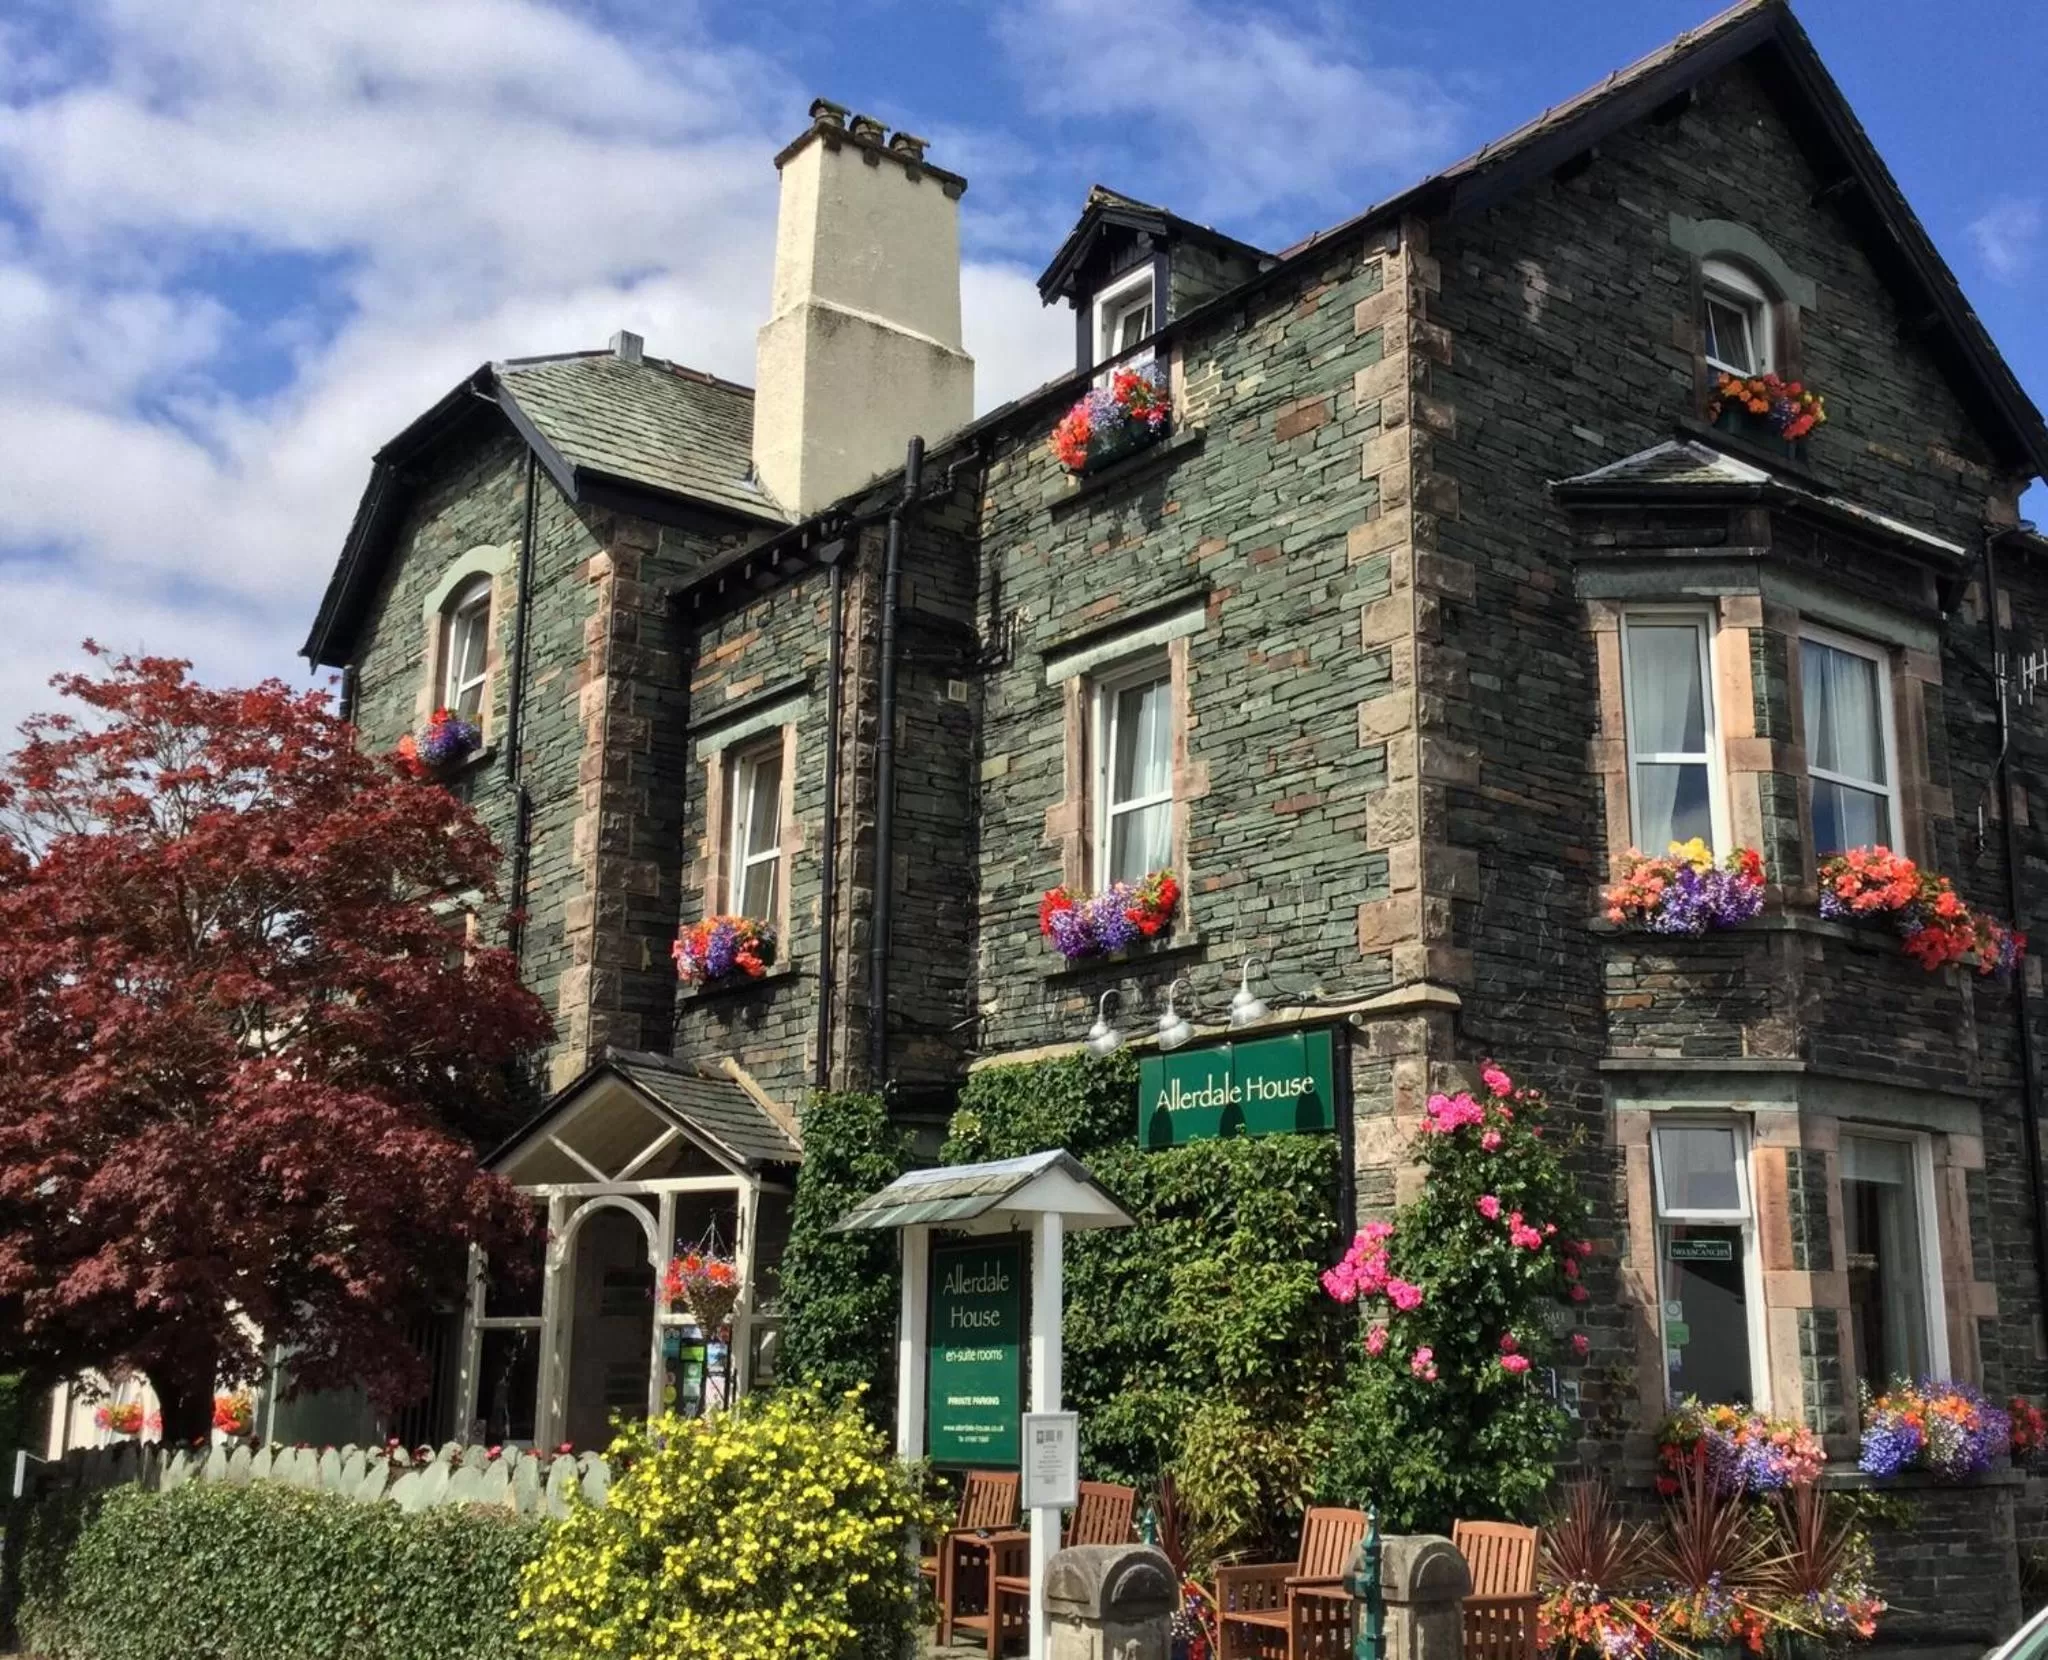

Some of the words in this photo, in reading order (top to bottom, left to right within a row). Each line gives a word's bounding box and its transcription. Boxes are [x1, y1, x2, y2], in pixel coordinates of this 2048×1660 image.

[1156, 1072, 1242, 1111] Allerdale
[1246, 1075, 1314, 1102] House
[943, 1260, 1010, 1296] Allerdale
[951, 1306, 1001, 1328] House
[945, 1348, 976, 1362] en-suite
[977, 1349, 1003, 1361] rooms
[947, 1396, 972, 1406] PRIVATE
[972, 1396, 1000, 1406] PARKING
